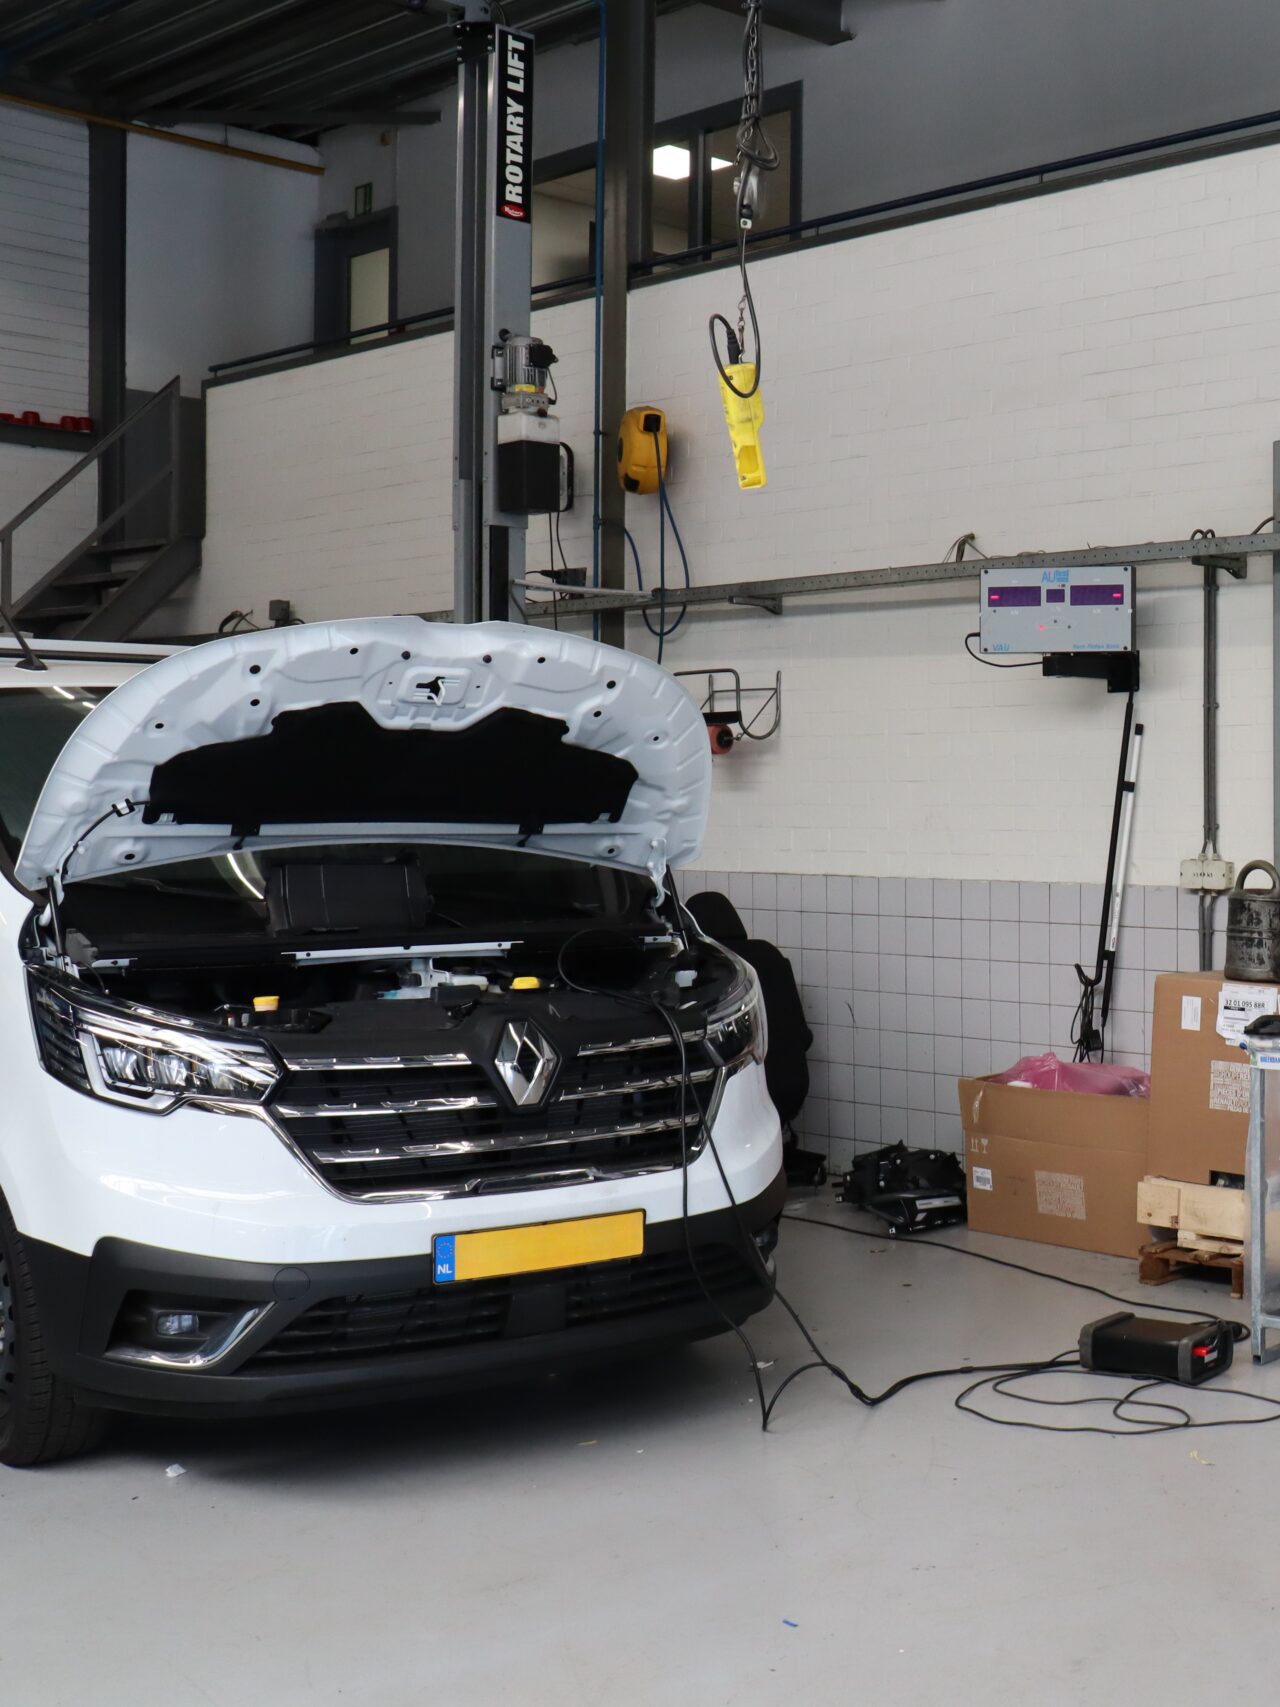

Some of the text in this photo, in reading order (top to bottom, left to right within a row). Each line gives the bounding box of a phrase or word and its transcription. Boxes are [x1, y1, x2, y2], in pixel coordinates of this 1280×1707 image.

[507, 34, 525, 93] LIFT
[505, 96, 524, 204] ROTARY
[1224, 998, 1233, 1006] 32
[1233, 999, 1241, 1007] 01
[1241, 999, 1253, 1008] 095
[437, 1263, 453, 1275] NL
